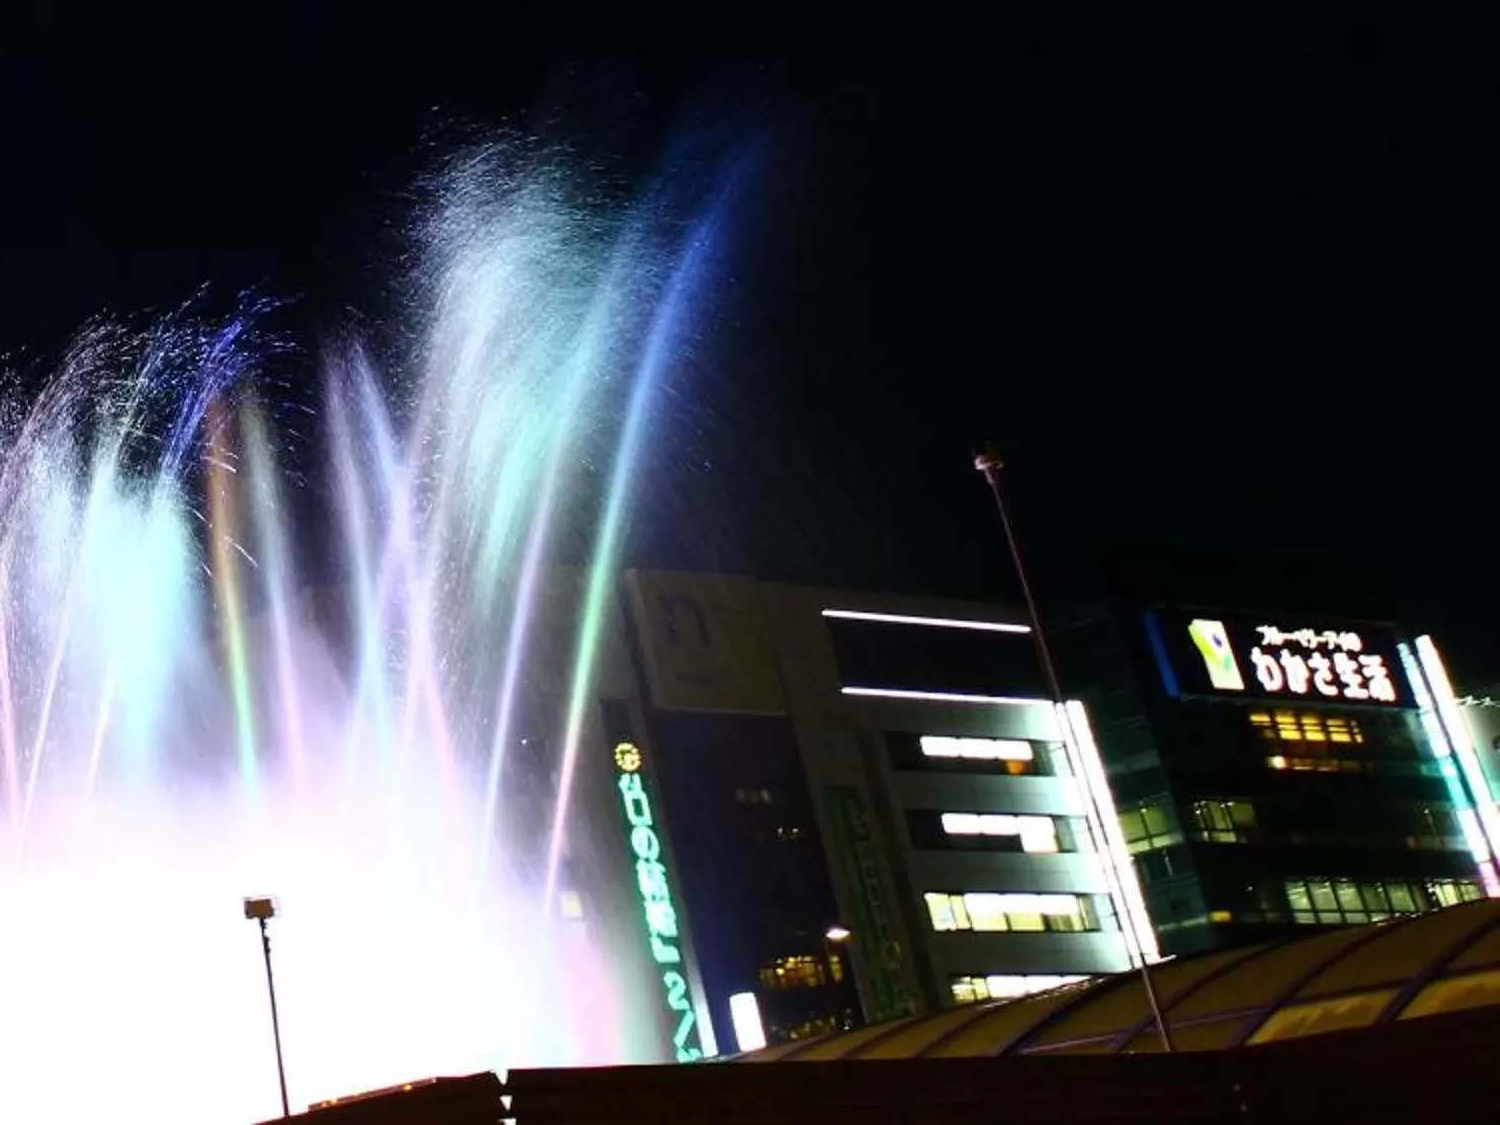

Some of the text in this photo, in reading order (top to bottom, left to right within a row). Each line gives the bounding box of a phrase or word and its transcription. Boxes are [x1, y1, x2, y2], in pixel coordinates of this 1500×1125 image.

[1251, 646, 1396, 702] わかさ生活
